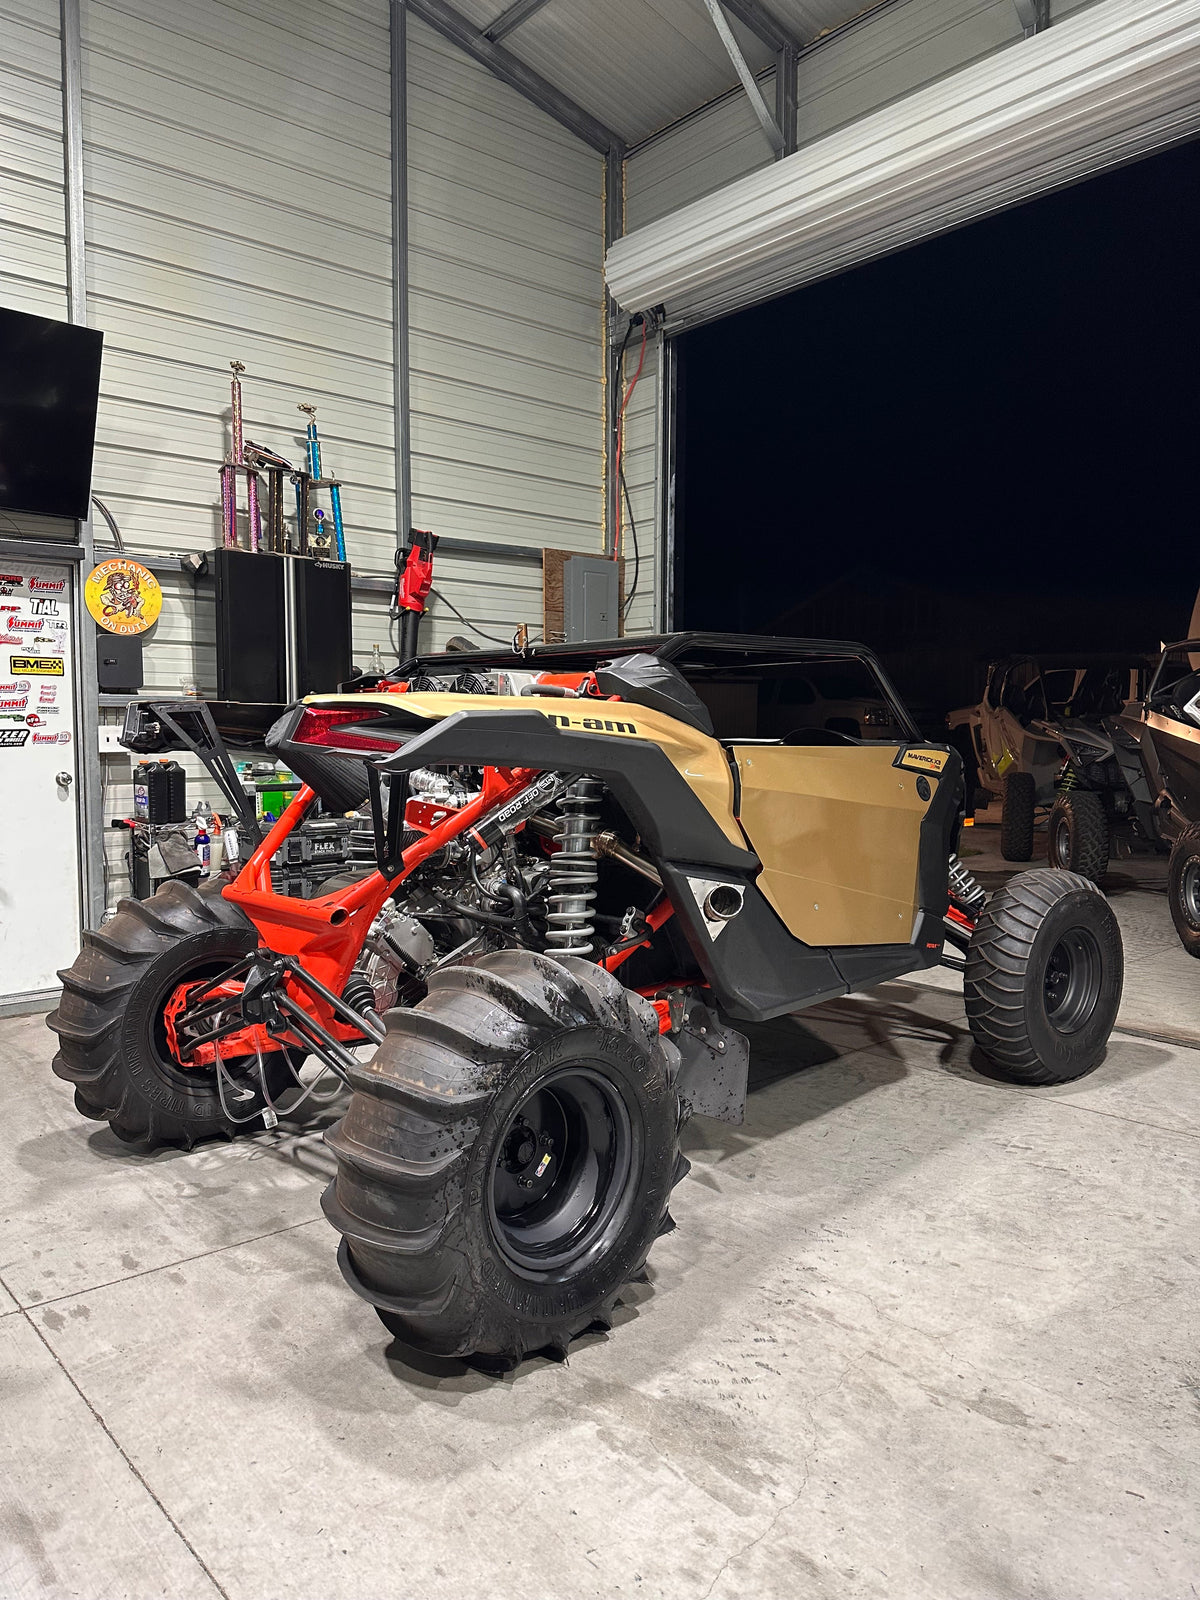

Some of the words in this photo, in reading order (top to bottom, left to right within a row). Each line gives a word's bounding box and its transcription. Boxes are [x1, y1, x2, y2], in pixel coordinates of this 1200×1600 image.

[322, 562, 345, 570] HUSKY
[92, 562, 156, 589] MECHANIC
[101, 616, 117, 631] ON
[120, 618, 149, 633] DUTY
[13, 659, 52, 670] BME
[0, 697, 28, 709] UMMIT
[548, 714, 637, 734] n-am
[314, 842, 335, 850] FLEX
